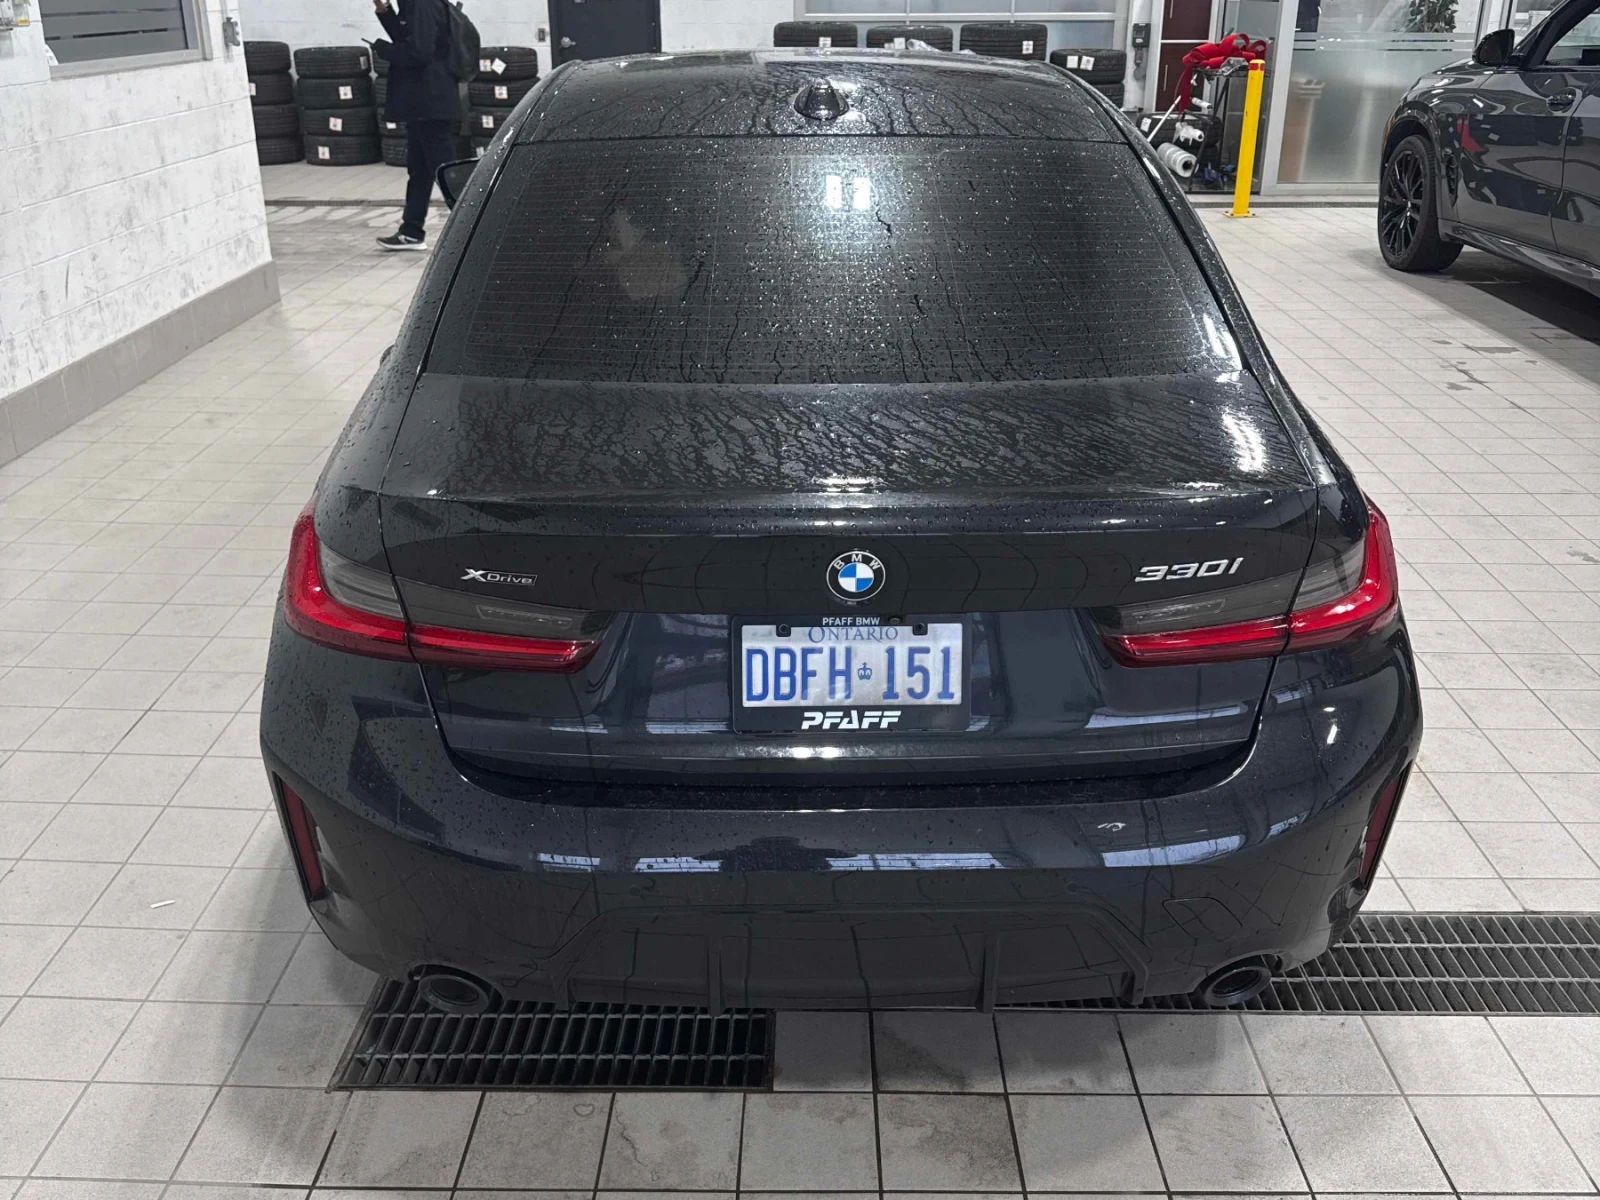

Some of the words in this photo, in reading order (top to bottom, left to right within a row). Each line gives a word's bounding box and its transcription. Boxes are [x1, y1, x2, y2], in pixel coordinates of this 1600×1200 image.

[833, 553, 881, 570] BMW
[822, 617, 854, 626] PFAFF
[856, 617, 880, 626] BMW
[808, 626, 899, 644] ONTARIO
[745, 647, 853, 702] DBFH
[882, 646, 955, 701] 151
[801, 709, 902, 731] PFAFF
